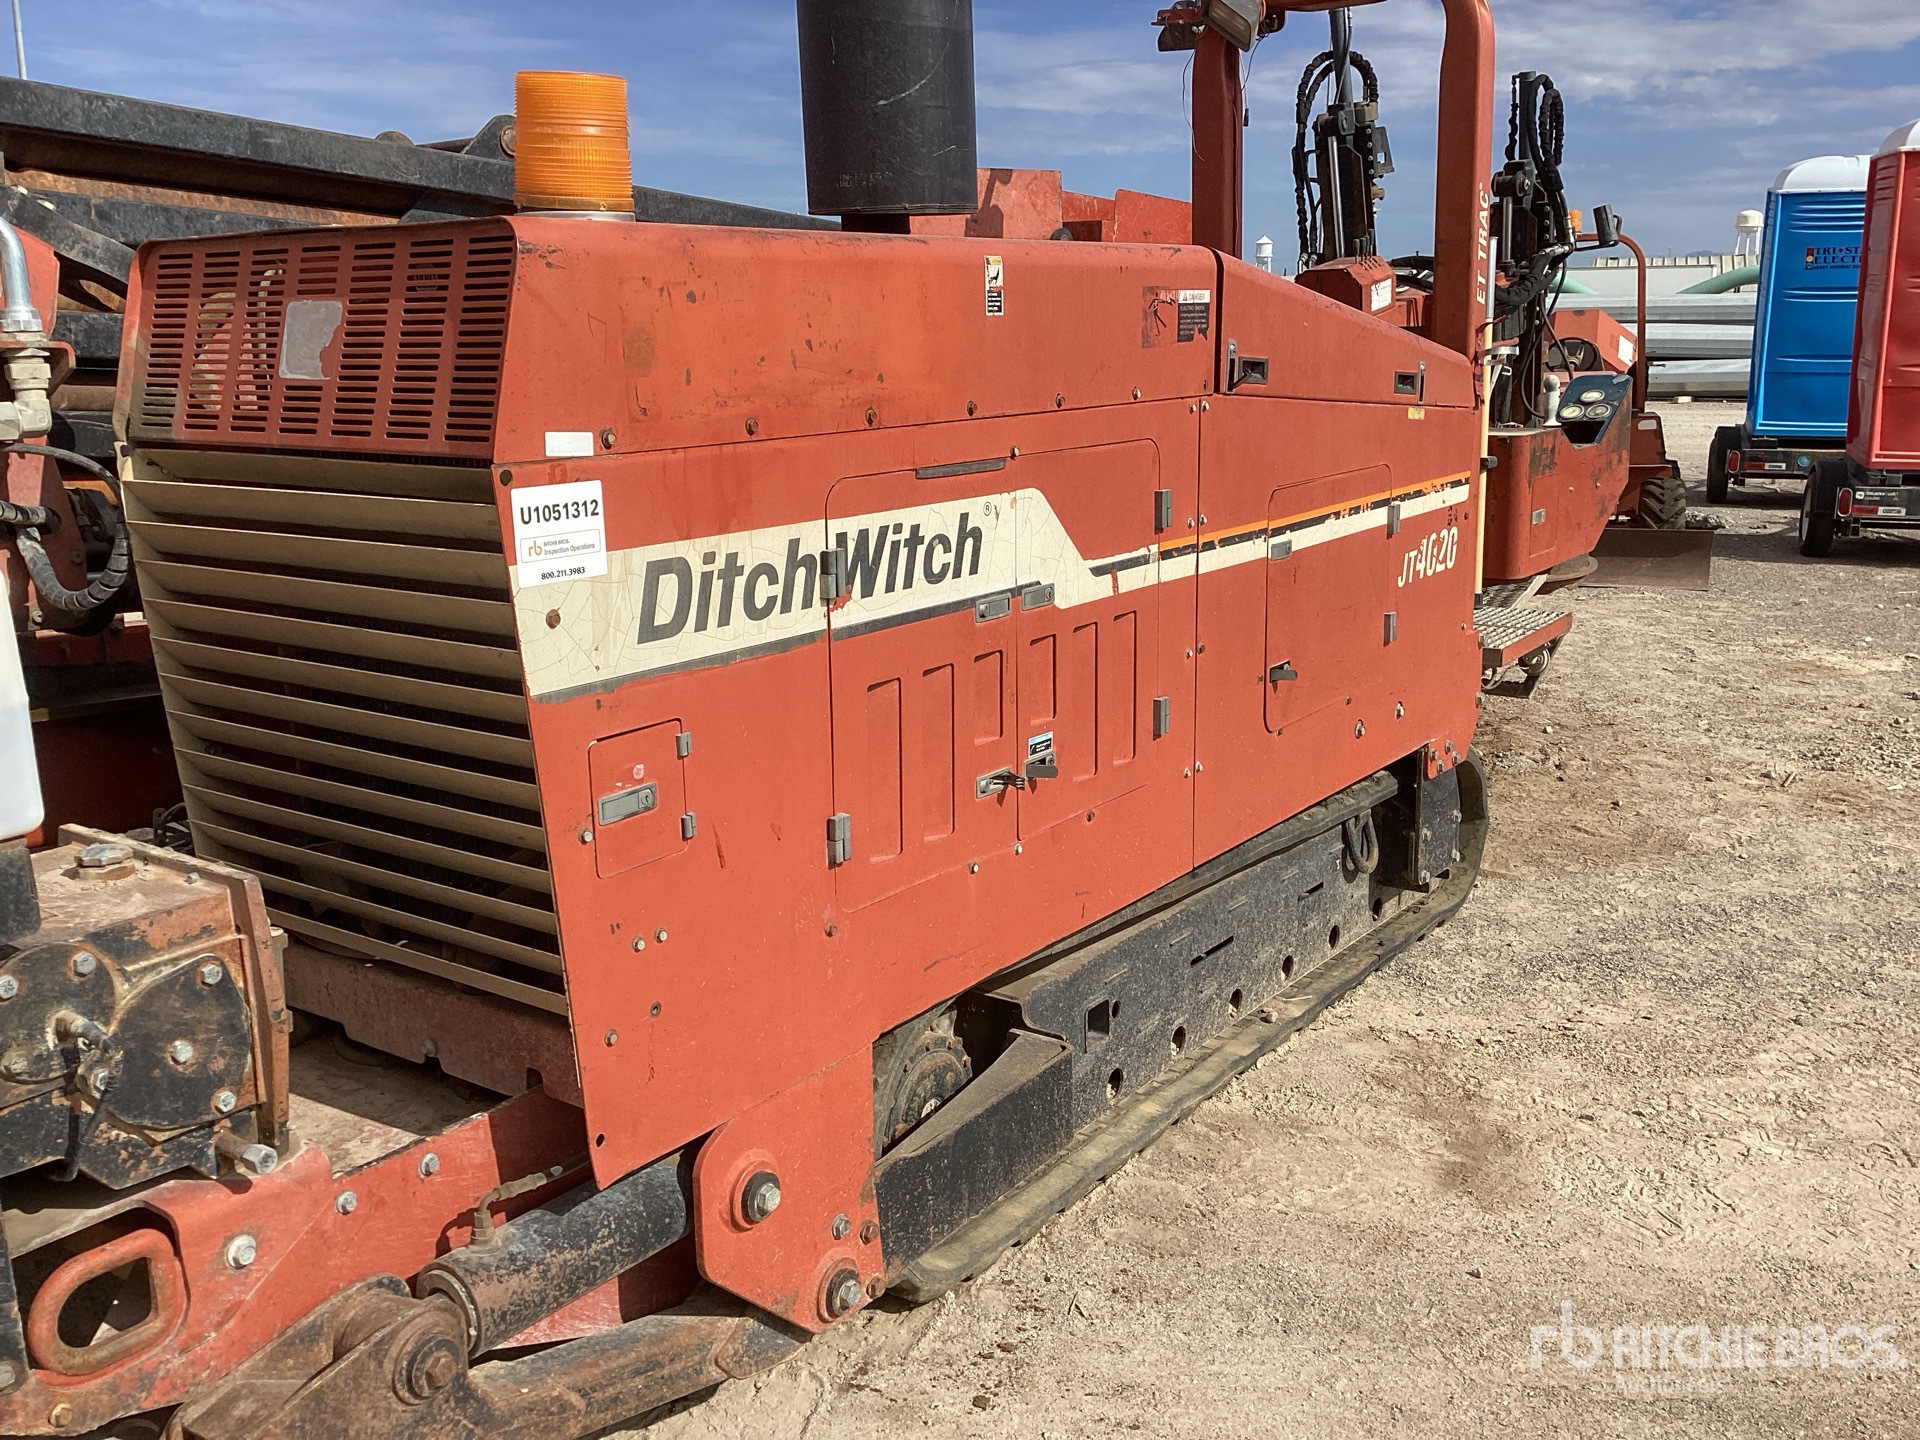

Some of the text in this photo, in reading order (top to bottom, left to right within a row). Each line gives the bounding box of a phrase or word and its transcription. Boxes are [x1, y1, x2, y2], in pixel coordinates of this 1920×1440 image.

[520, 499, 599, 525] U1051312
[544, 543, 596, 555] Inspection Operations
[541, 566, 586, 580] 800.211.3983
[637, 537, 818, 645] Ditch
[835, 511, 984, 599] Witch
